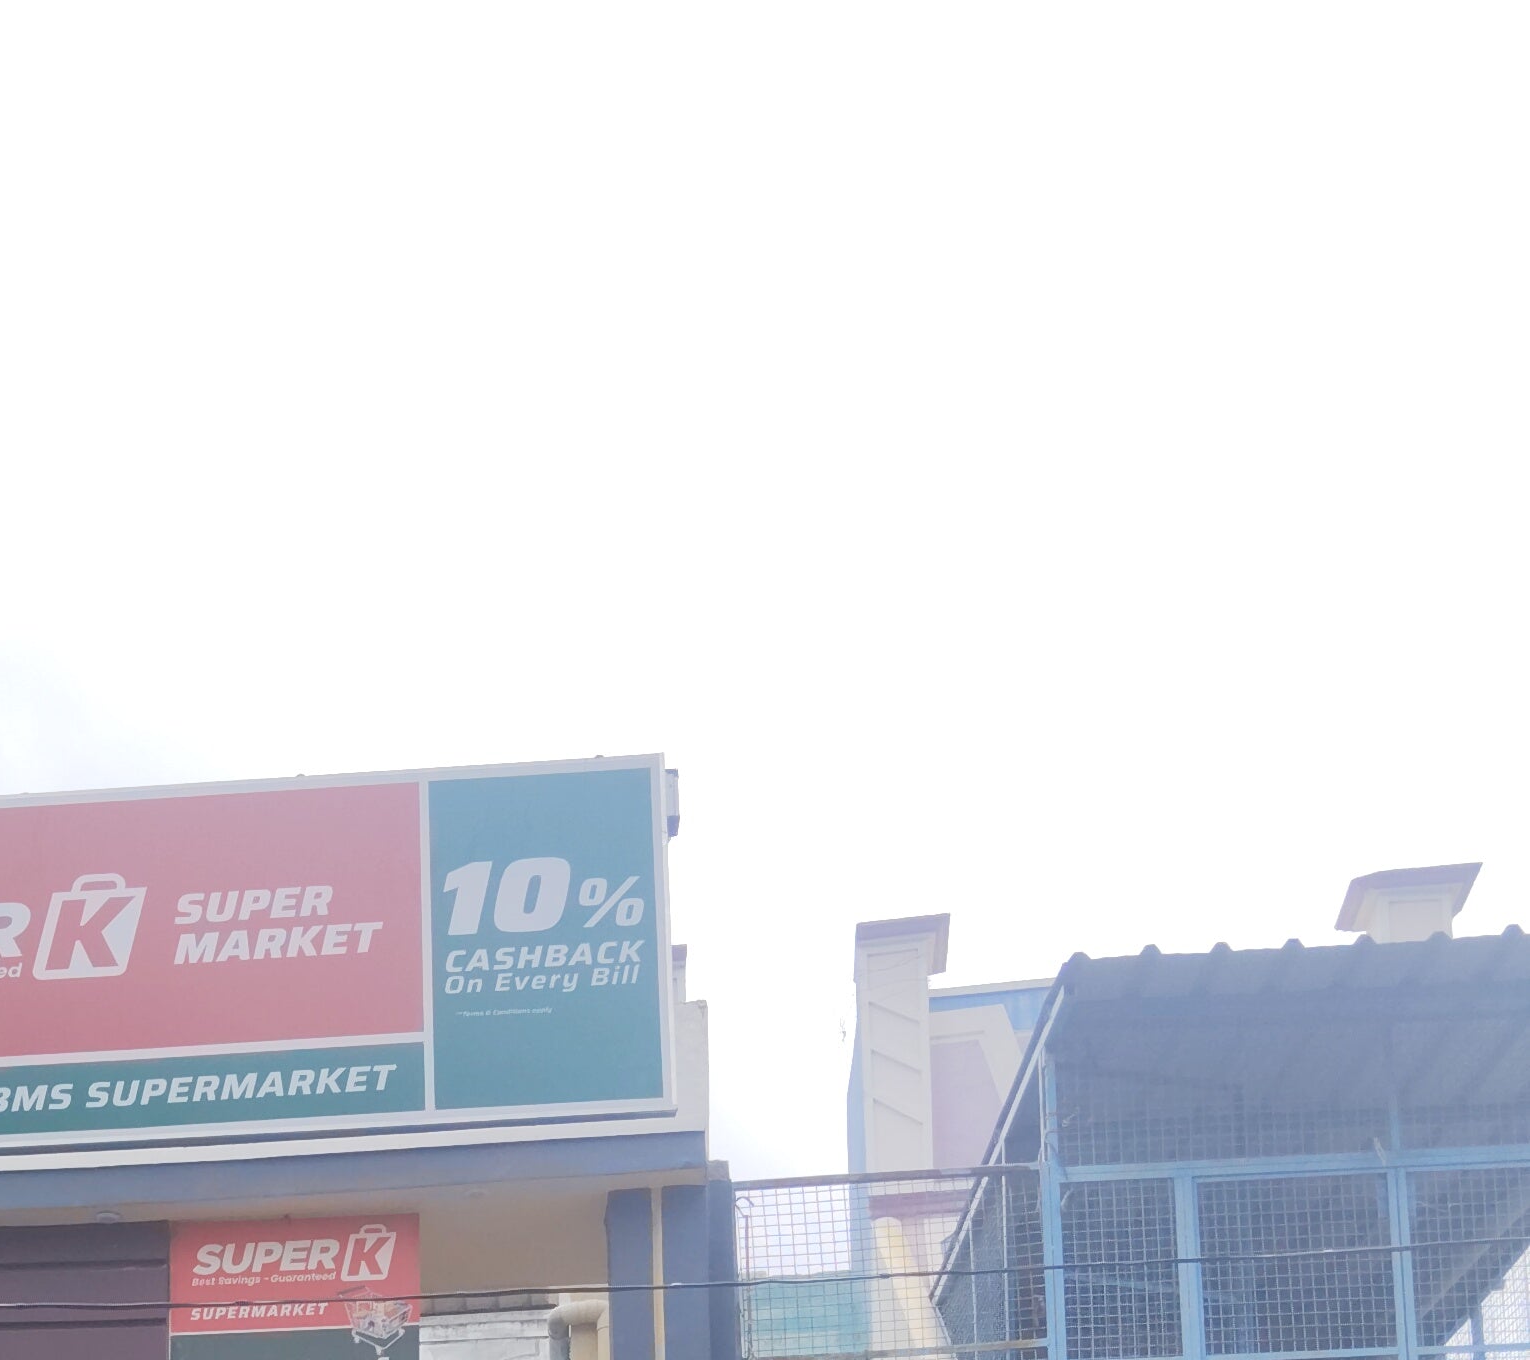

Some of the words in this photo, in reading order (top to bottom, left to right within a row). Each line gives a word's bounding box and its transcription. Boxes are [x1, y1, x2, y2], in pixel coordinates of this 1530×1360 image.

[174, 885, 333, 924] SUPER
[442, 857, 645, 936] 10%
[174, 921, 383, 965] MARKET
[445, 940, 645, 973] CASHBACK
[444, 974, 484, 995] On
[495, 970, 579, 992] Every
[591, 964, 640, 986] Bill
[85, 1063, 397, 1108] SUPERMARKET
[192, 1239, 340, 1275] SUPER
[191, 1302, 328, 1321] SUPERMARKET
